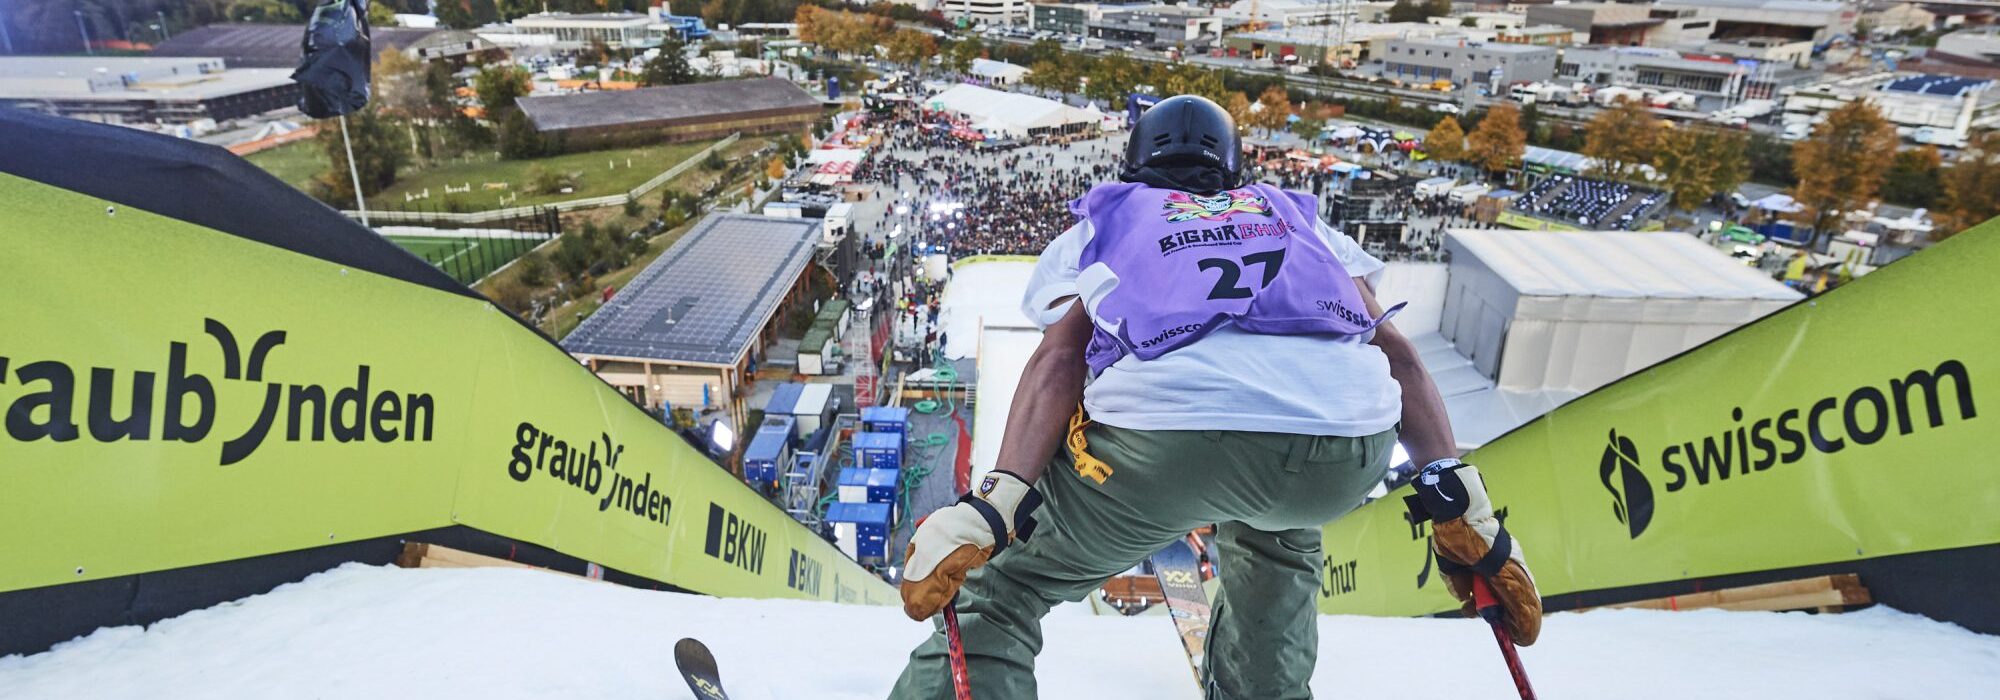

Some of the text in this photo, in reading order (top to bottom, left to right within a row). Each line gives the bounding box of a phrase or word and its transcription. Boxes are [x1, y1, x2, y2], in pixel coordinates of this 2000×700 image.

[1197, 247, 1287, 300] 27
[1141, 323, 1206, 349] swissco
[1661, 359, 1978, 493] swisscom
[723, 511, 767, 575] BKW
[798, 553, 822, 597] BKW
[1321, 554, 1357, 599] Chur
